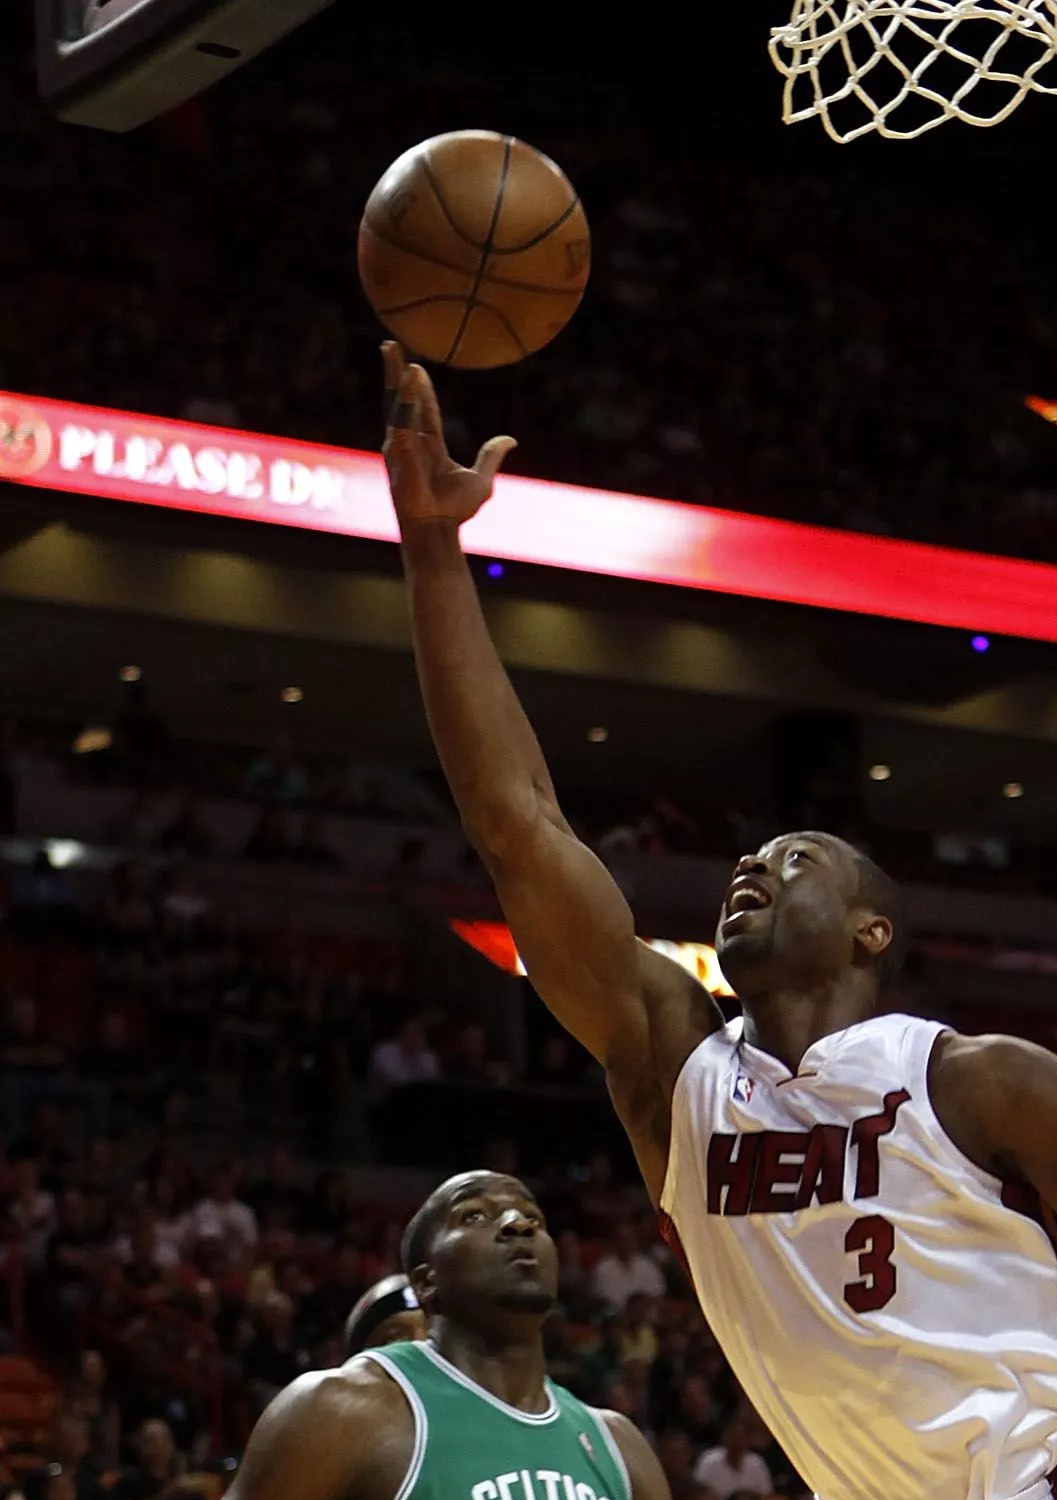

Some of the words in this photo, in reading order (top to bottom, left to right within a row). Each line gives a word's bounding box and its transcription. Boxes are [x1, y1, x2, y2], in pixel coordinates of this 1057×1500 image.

[59, 425, 264, 499] PLEASE
[707, 1087, 912, 1216] HEAT
[844, 1214, 897, 1314] 3
